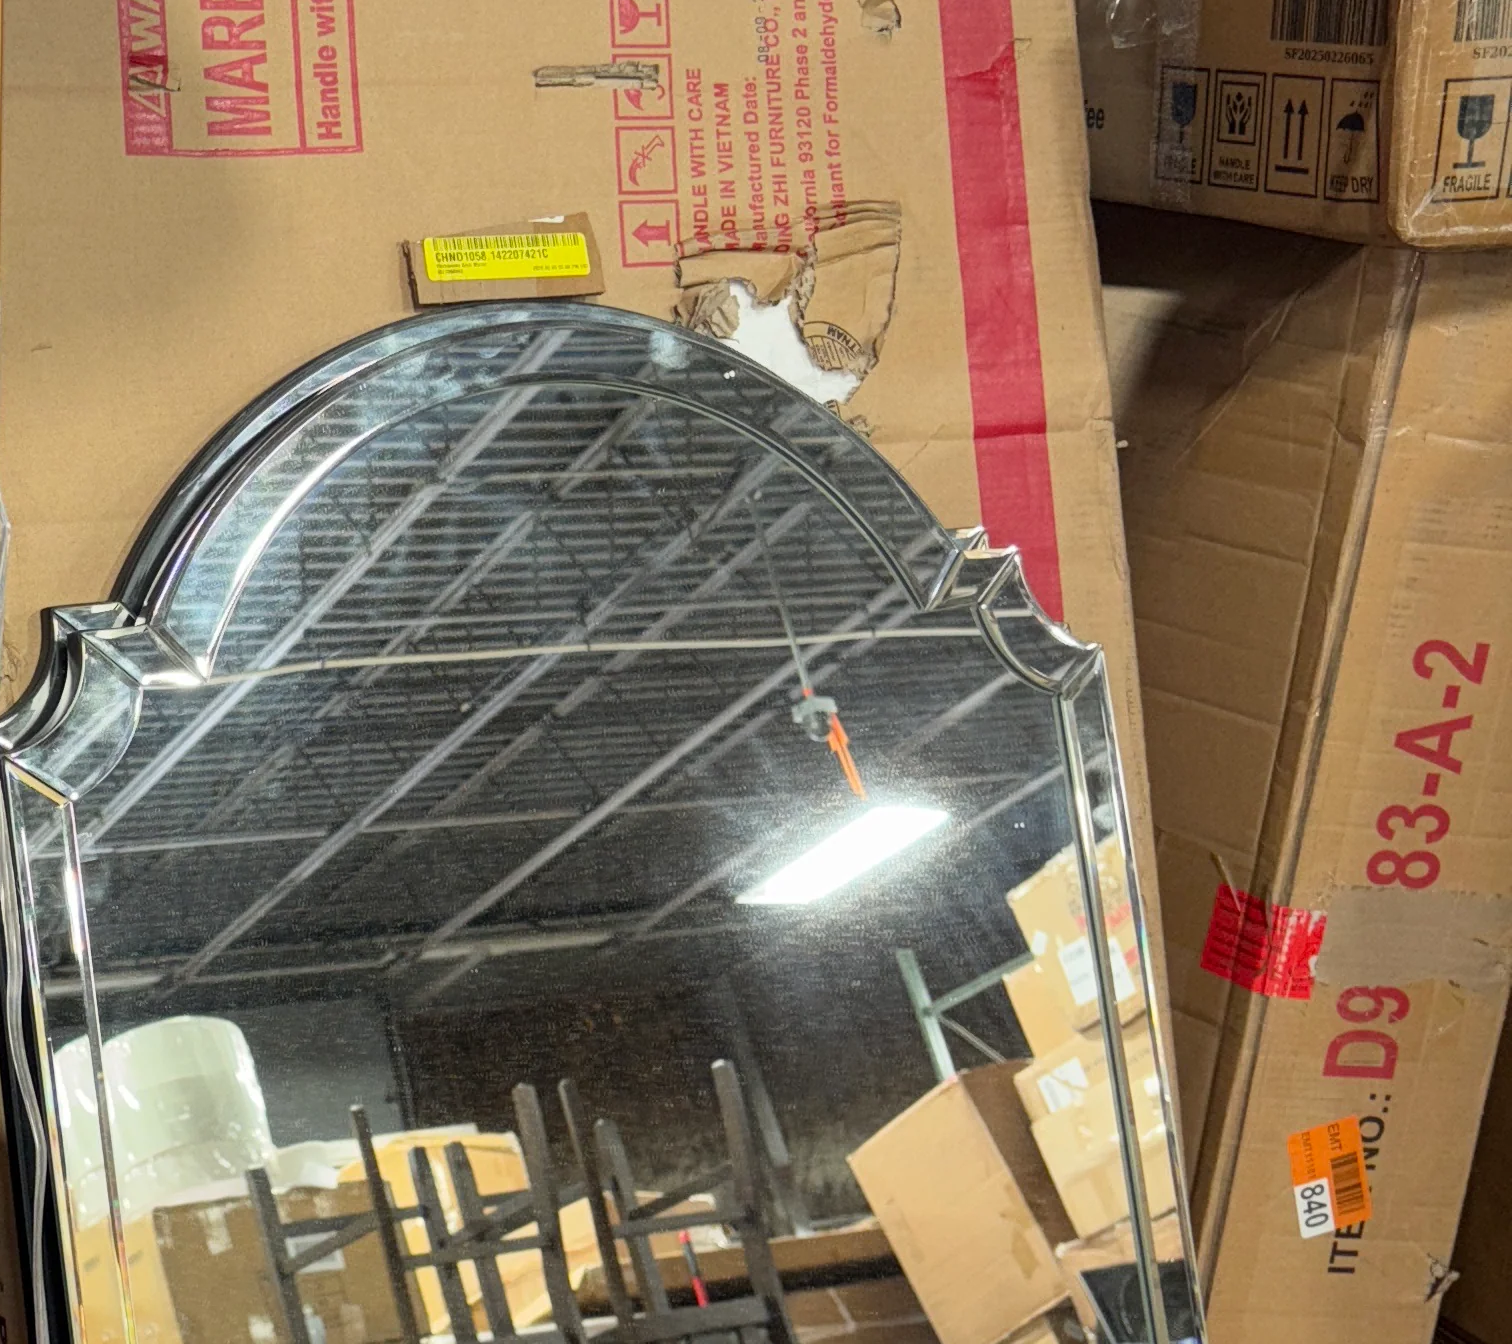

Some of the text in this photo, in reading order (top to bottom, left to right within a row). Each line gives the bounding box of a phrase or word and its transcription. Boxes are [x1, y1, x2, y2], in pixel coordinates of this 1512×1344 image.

[763, 6, 782, 49] CO.,
[791, 26, 807, 38] 2
[312, 45, 343, 141] Handle
[685, 68, 704, 123] CARE
[793, 44, 811, 100] Phase
[742, 75, 760, 127] Date:
[765, 53, 787, 168] FURNITURE
[689, 127, 707, 178] WITH
[713, 83, 734, 174] VIETNAM
[794, 105, 814, 164] 93120
[824, 129, 841, 157] for
[719, 179, 737, 200] IN
[771, 175, 790, 207] ZHI
[1350, 175, 1376, 195] DRY
[1442, 173, 1492, 193] FRAGILE
[1365, 638, 1491, 892] 83-A-2
[1327, 1122, 1343, 1153] EMT
[1299, 1184, 1330, 1228] 840
[1327, 1218, 1366, 1276] ITE
